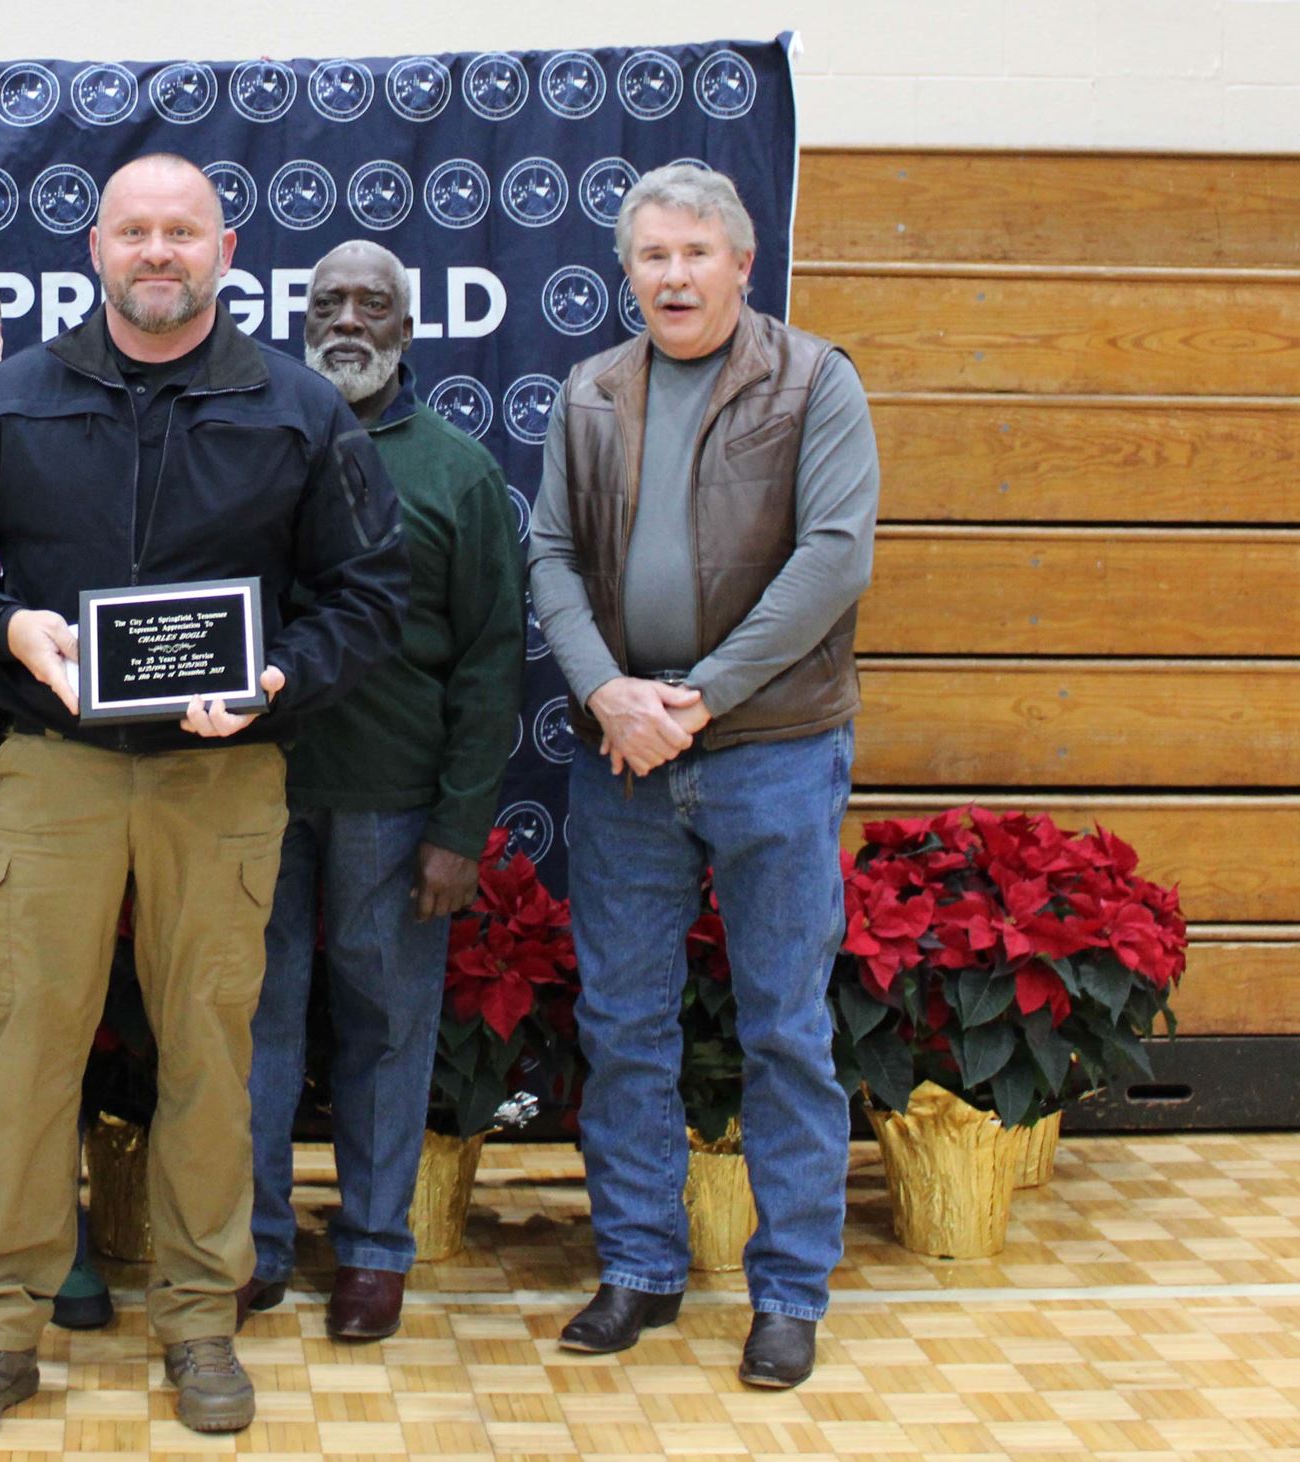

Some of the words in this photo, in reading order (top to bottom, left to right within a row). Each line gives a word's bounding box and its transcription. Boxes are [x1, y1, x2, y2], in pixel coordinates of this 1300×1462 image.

[158, 614, 194, 623] Springfield,
[197, 612, 227, 620] Tennessee
[162, 622, 201, 631] Appreciation
[138, 634, 178, 643] CHARLES
[179, 631, 208, 640] BOGLE
[131, 658, 142, 666] For
